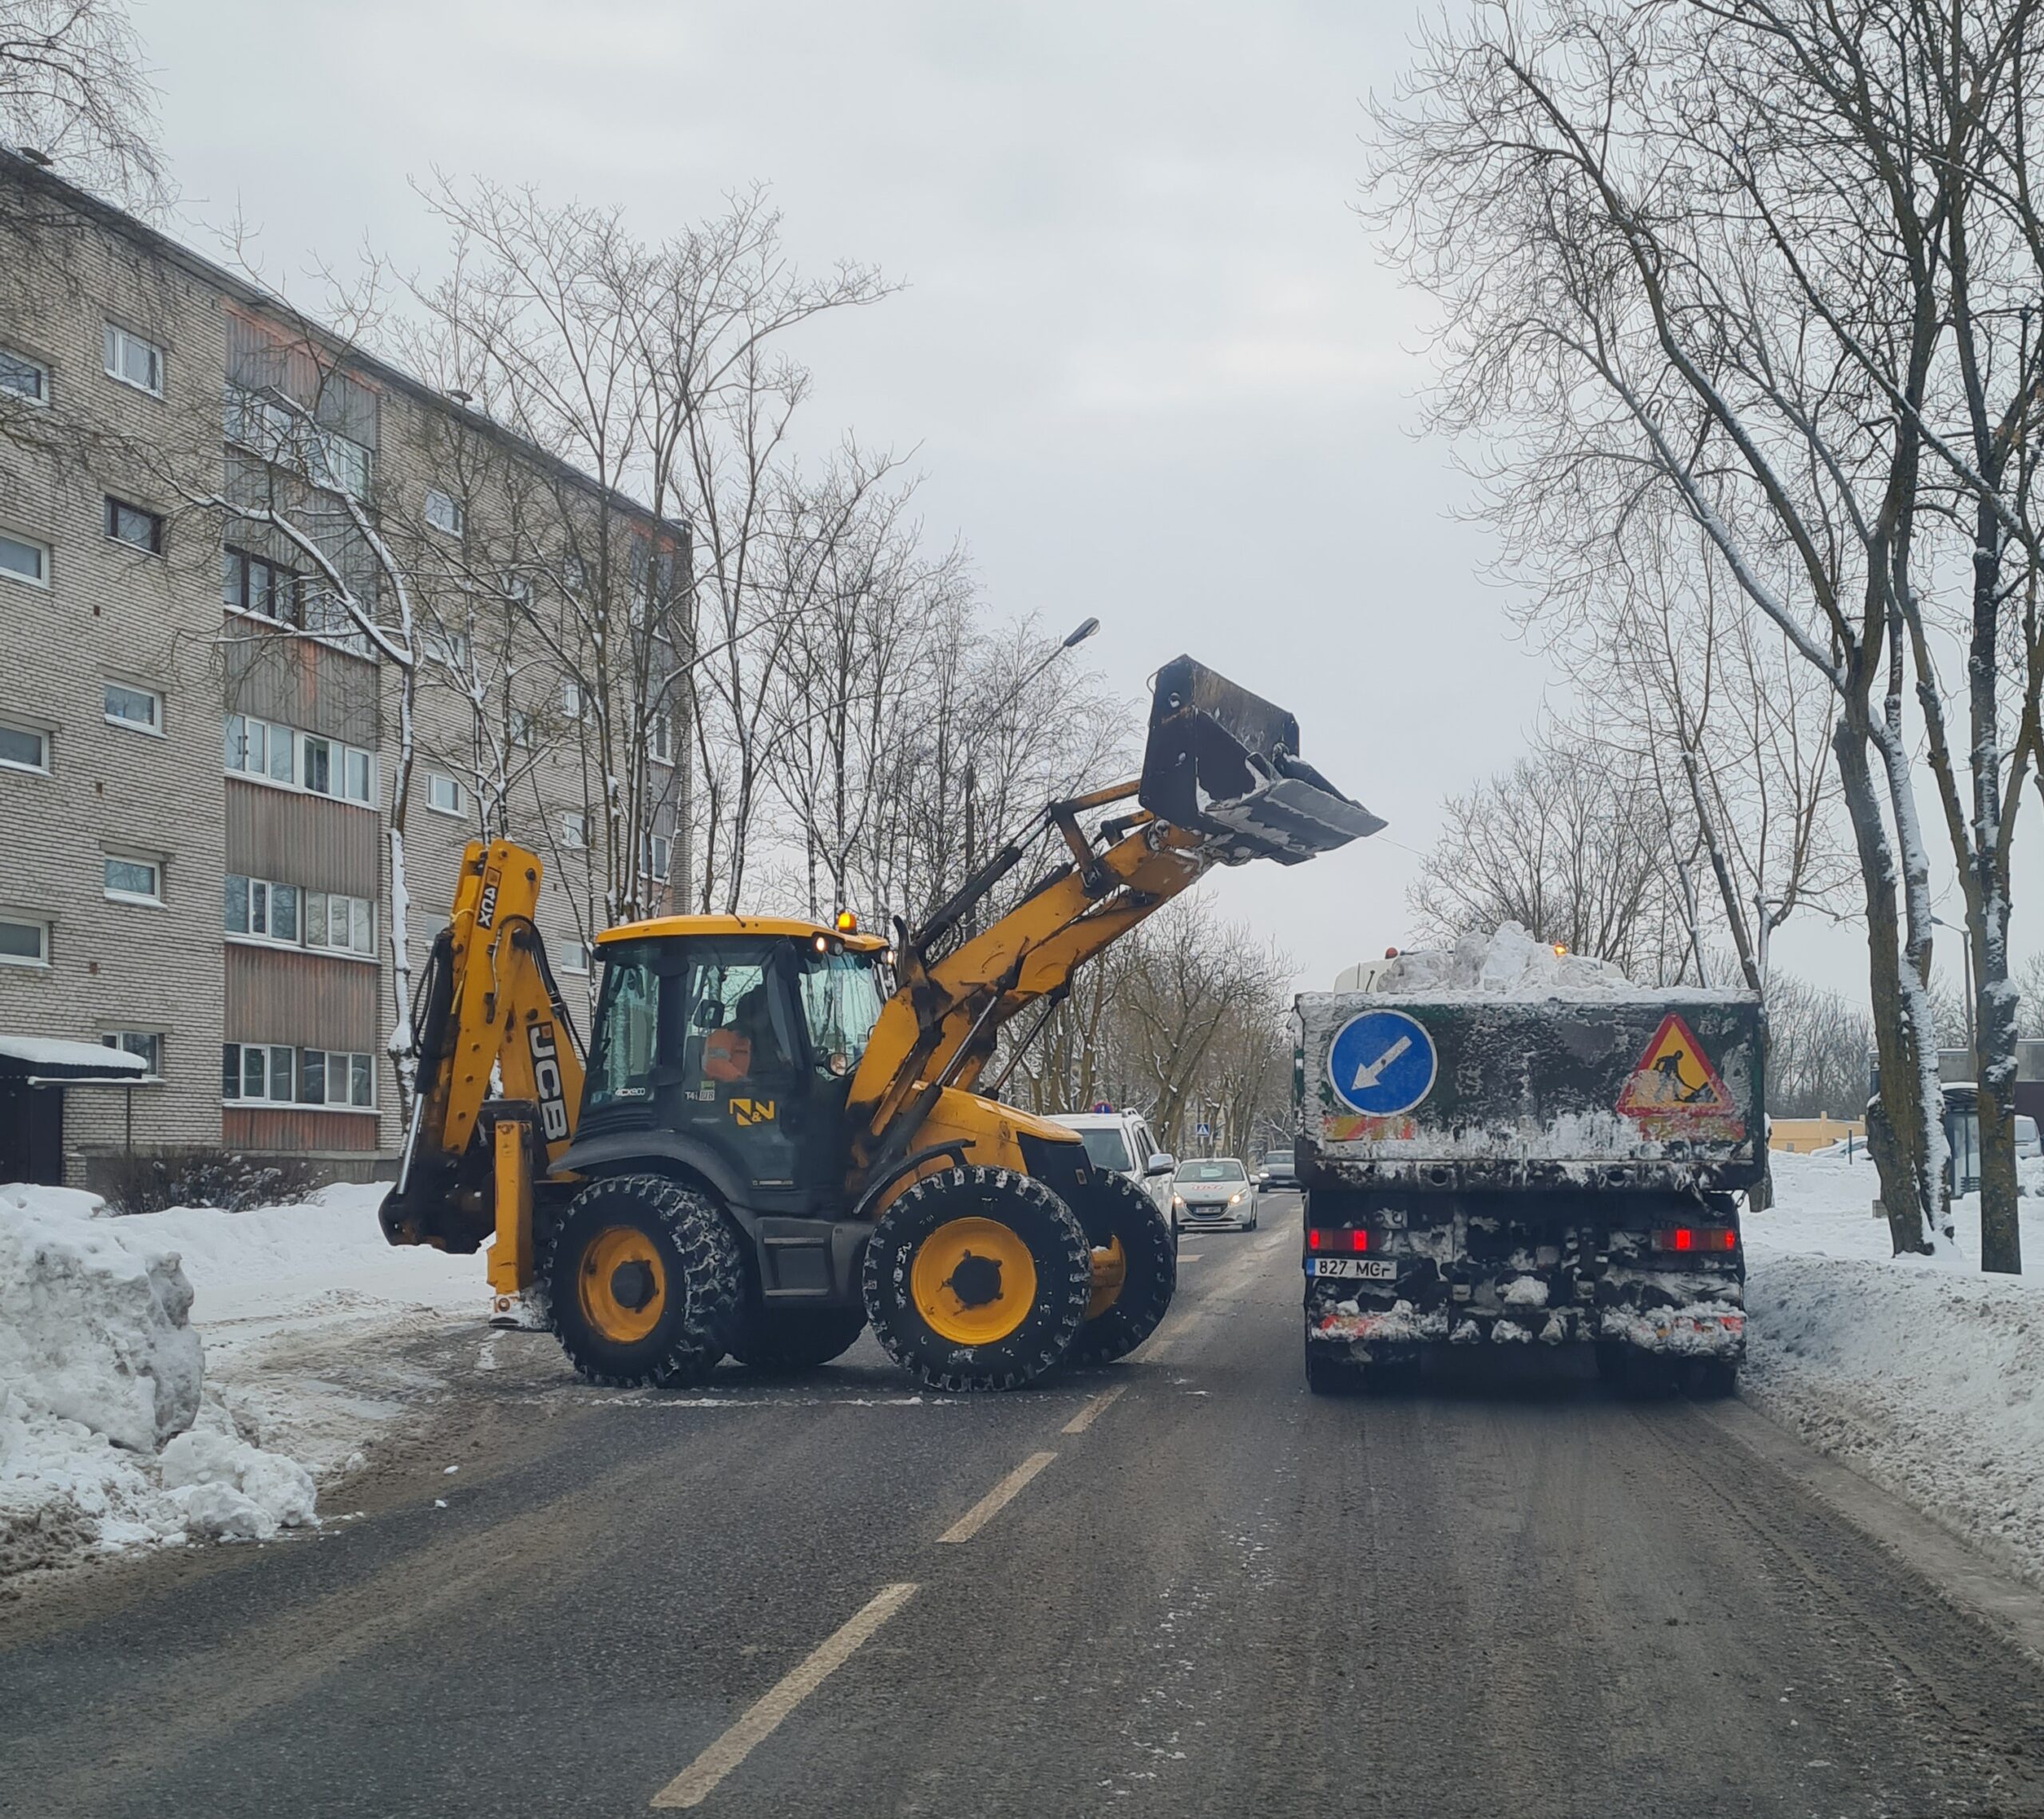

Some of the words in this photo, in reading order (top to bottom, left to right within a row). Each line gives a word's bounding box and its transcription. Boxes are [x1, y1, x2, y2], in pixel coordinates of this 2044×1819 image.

[477, 887, 496, 927] 4CX
[529, 1027, 568, 1140] JCB
[1319, 1259, 1349, 1275] 827
